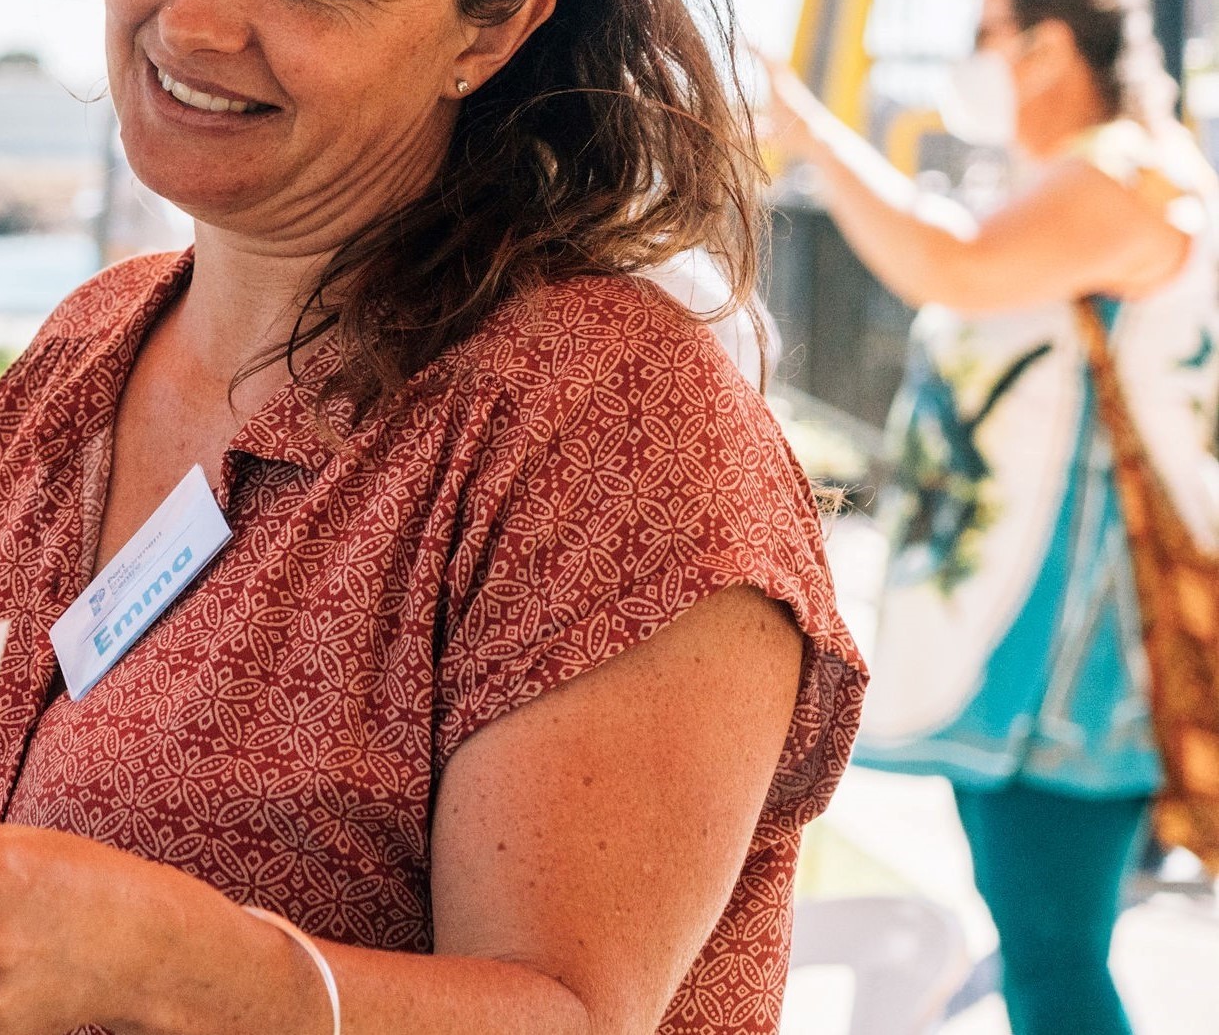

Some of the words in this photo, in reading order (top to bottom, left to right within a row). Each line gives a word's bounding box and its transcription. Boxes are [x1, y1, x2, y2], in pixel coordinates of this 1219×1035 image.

[107, 563, 126, 584] Port
[109, 531, 163, 590] Environment
[93, 546, 193, 656] Emma
